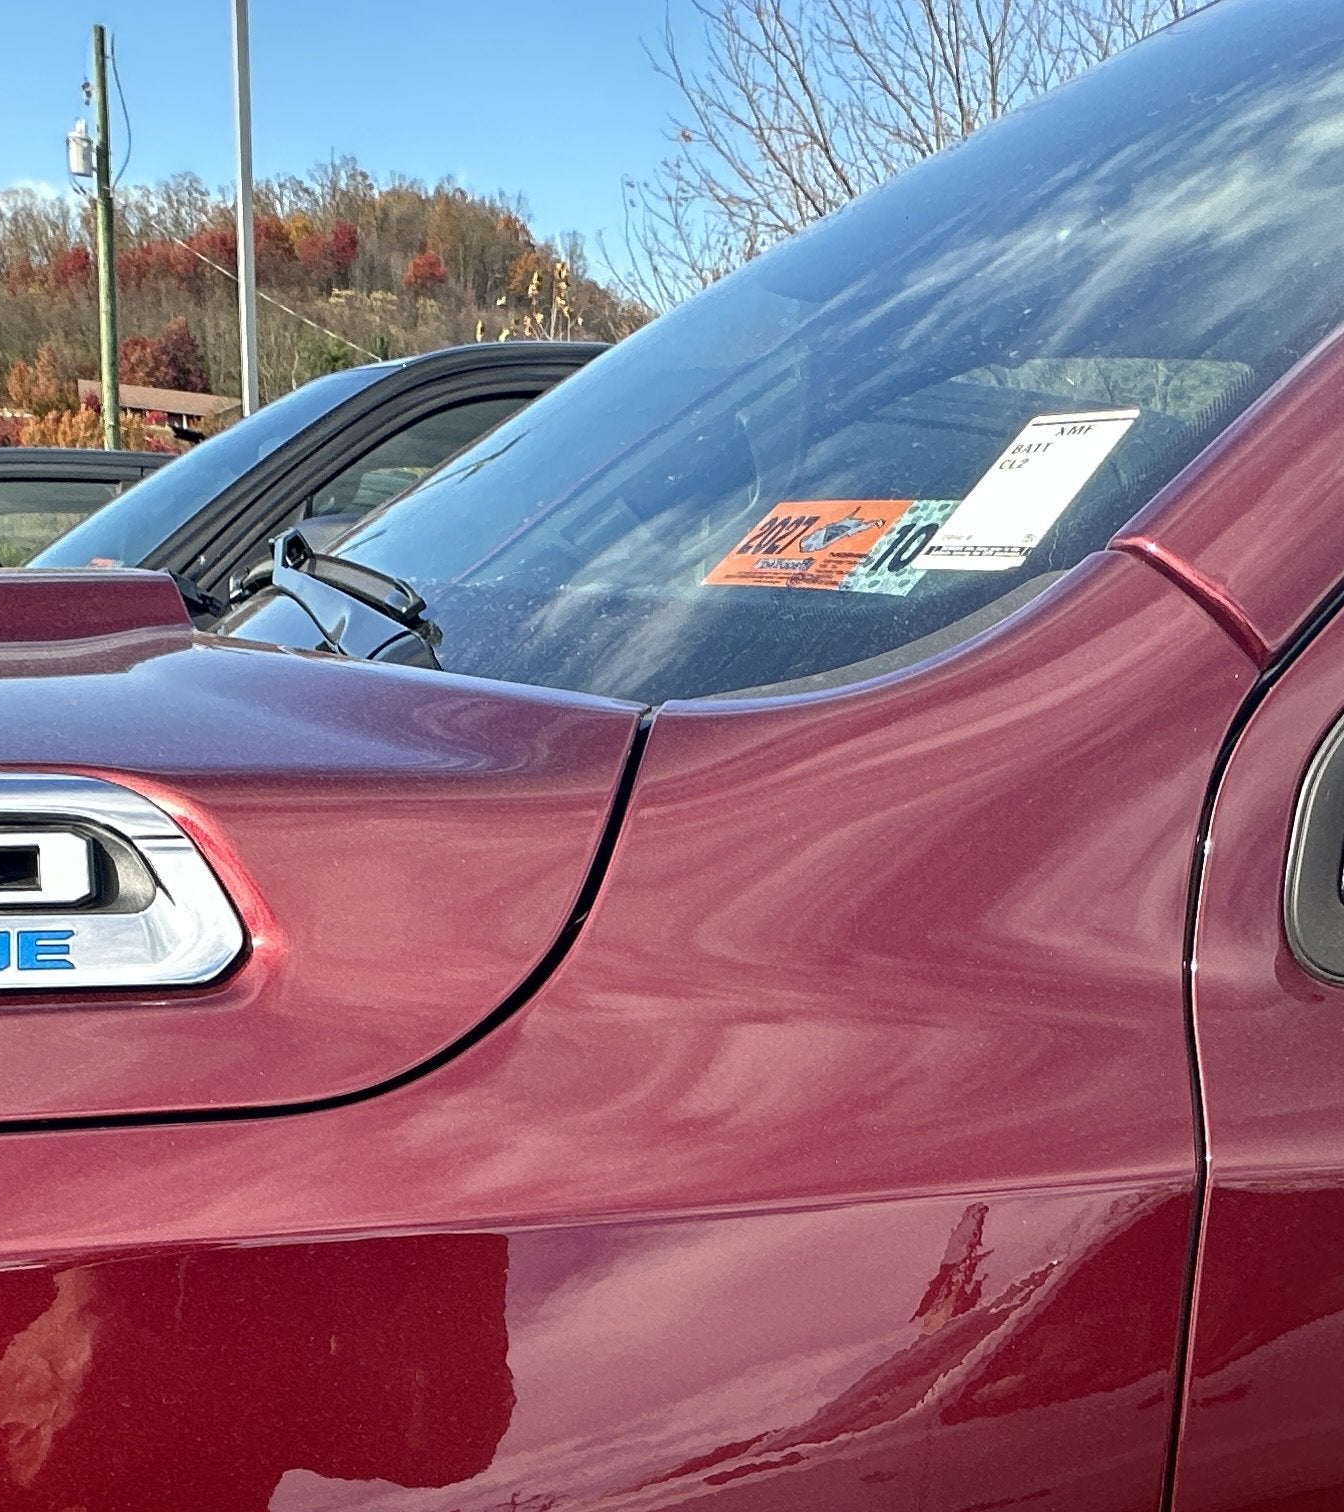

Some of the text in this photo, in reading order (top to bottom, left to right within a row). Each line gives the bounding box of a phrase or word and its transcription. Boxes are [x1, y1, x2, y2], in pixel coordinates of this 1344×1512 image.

[1011, 442, 1053, 455] BATT
[736, 516, 821, 555] 2027
[869, 522, 940, 572] 10
